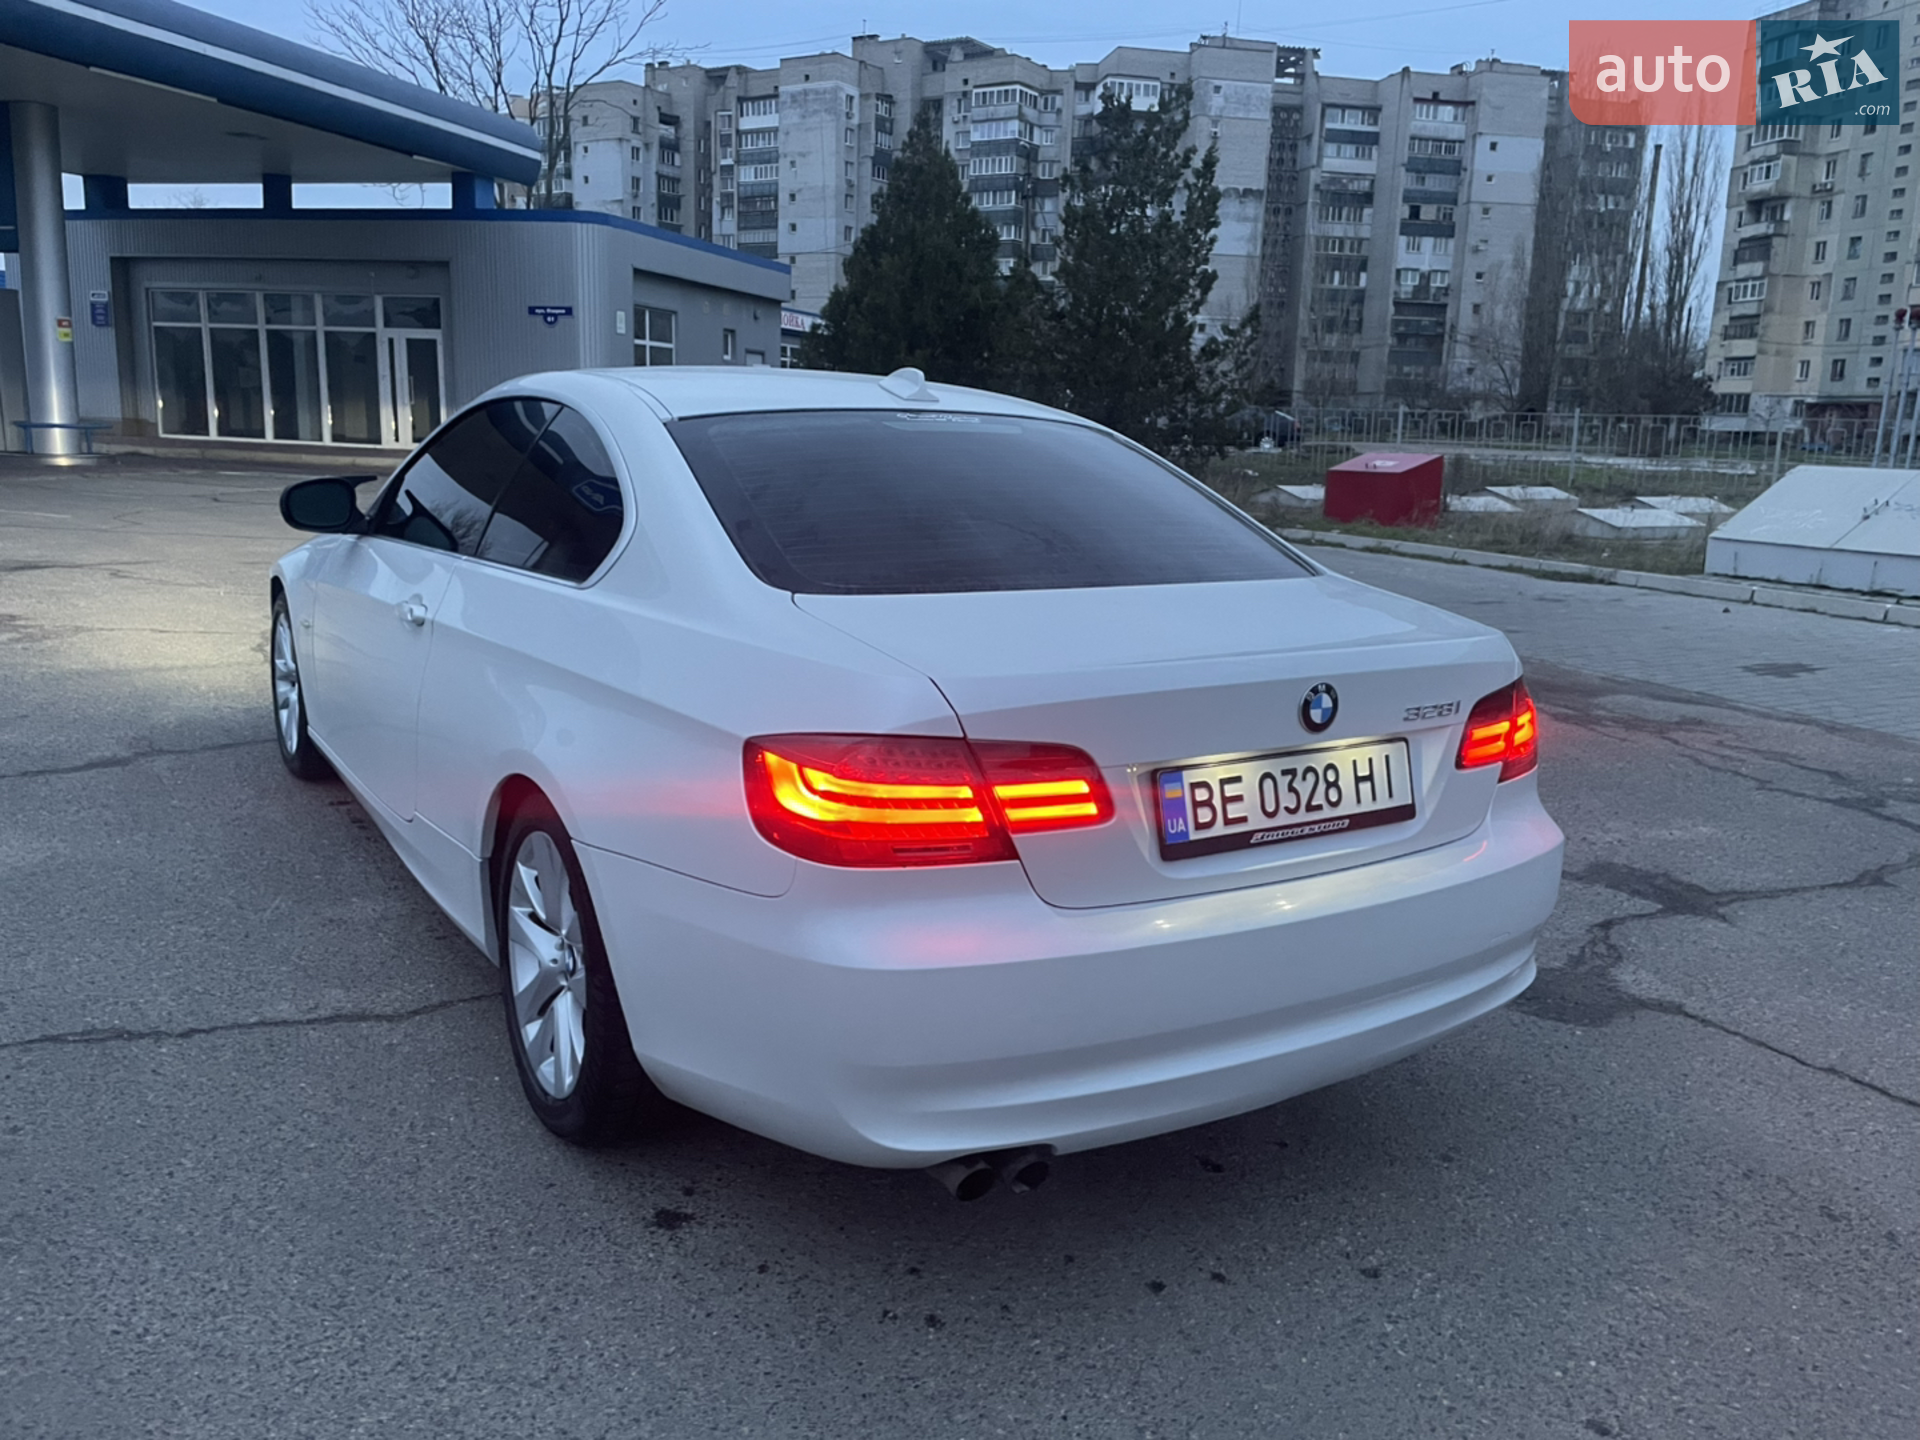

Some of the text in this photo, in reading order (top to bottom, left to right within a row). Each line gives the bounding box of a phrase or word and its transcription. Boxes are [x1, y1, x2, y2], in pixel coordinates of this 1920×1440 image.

[781, 312, 806, 330] ОЙКА
[1188, 754, 1394, 831] BE 0328 HI
[1167, 817, 1187, 835] UA
